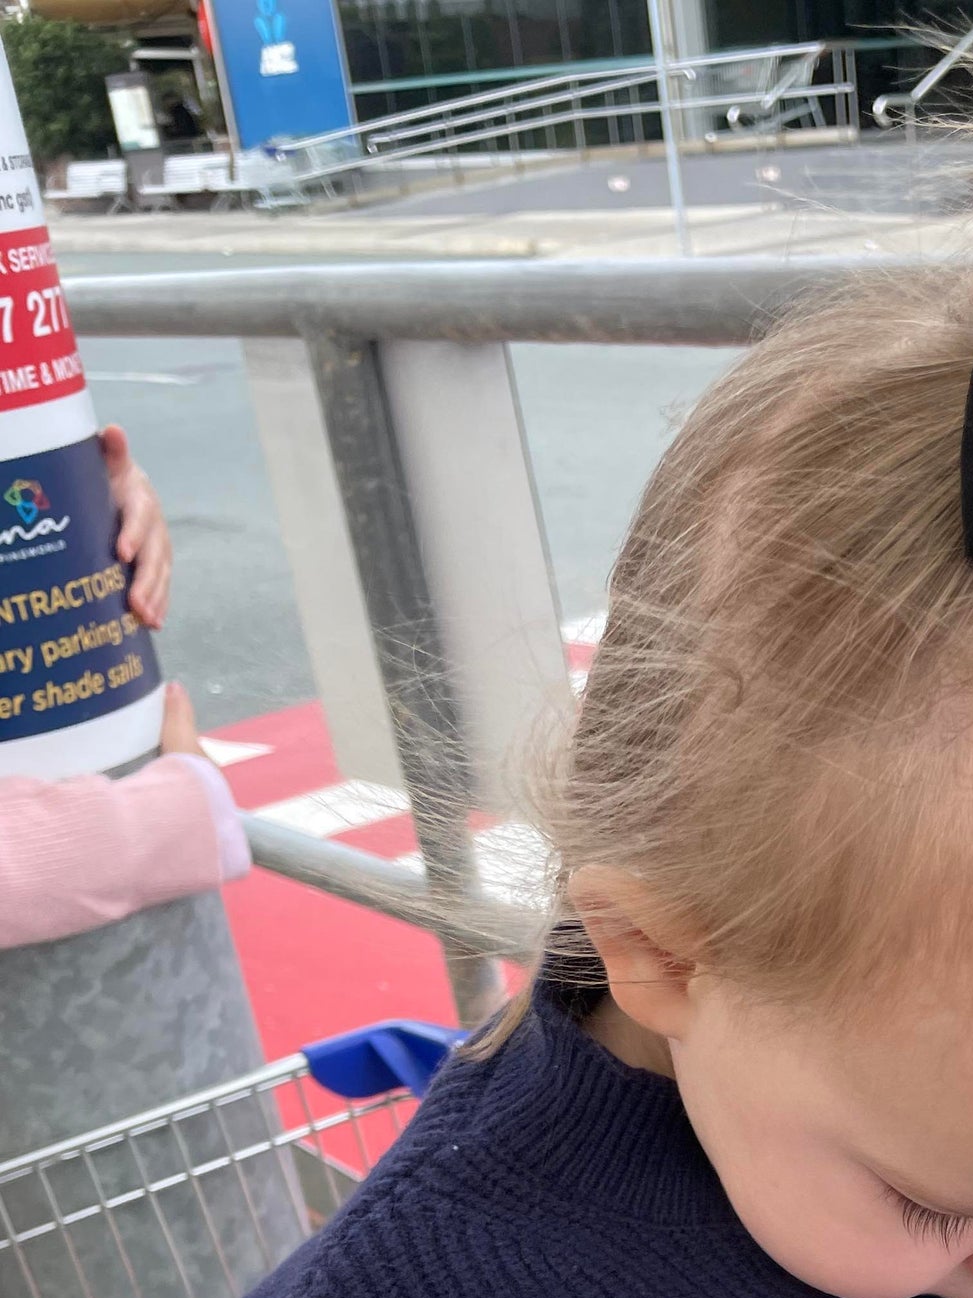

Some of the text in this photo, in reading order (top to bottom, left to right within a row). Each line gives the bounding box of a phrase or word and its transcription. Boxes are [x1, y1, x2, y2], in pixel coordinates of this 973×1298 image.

[40, 618, 123, 669] parking
[32, 669, 105, 713] shade
[107, 653, 144, 689] sails
